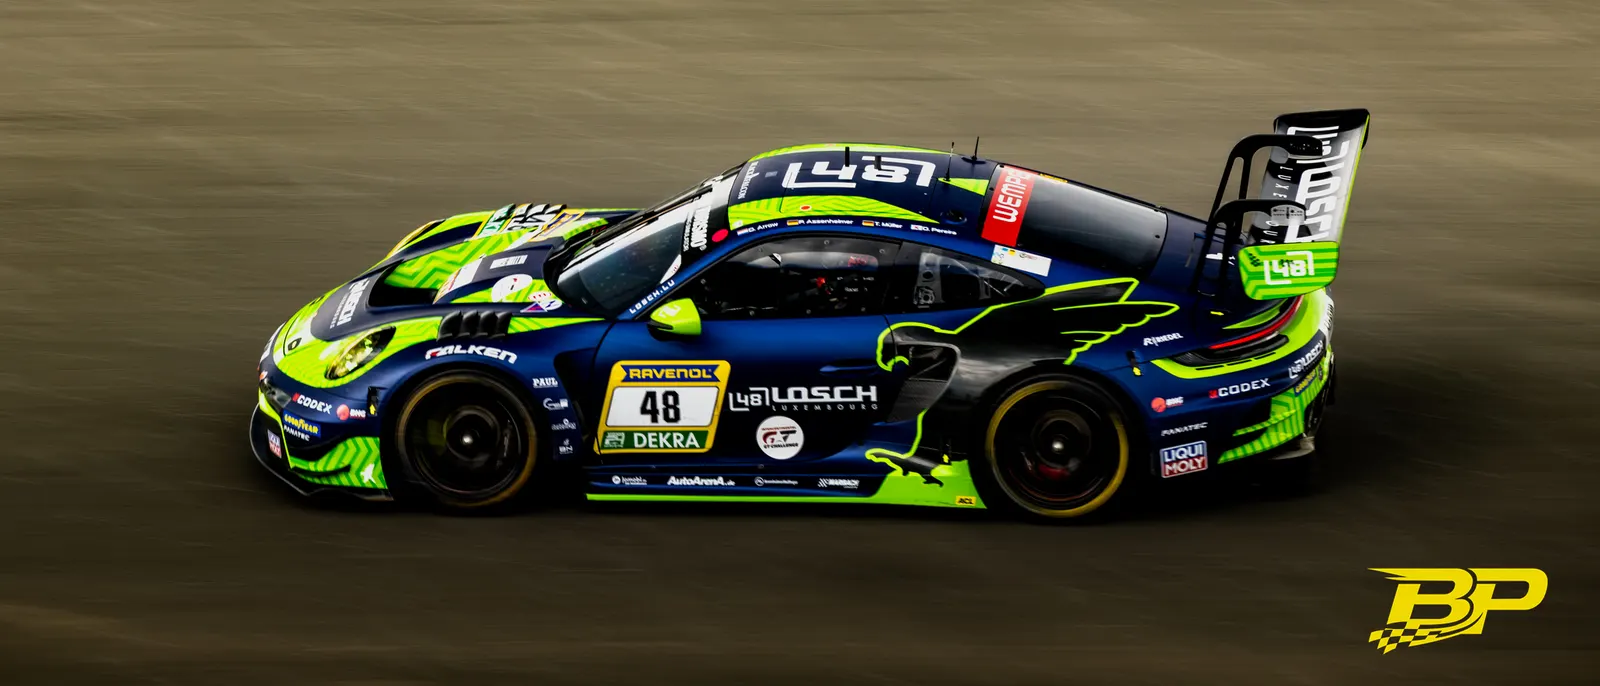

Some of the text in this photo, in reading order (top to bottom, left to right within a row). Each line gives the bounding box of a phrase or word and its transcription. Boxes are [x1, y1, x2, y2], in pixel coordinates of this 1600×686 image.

[424, 344, 518, 365] FALKEN
[532, 376, 559, 388] PAUL
[1218, 377, 1271, 398] CODEX
[296, 393, 333, 415] CODEX
[771, 385, 878, 403] LOSCH
[640, 390, 681, 424] 48
[633, 432, 701, 449] DEKRA
[1163, 443, 1204, 463] LIQUI
[1164, 456, 1205, 476] MOLY
